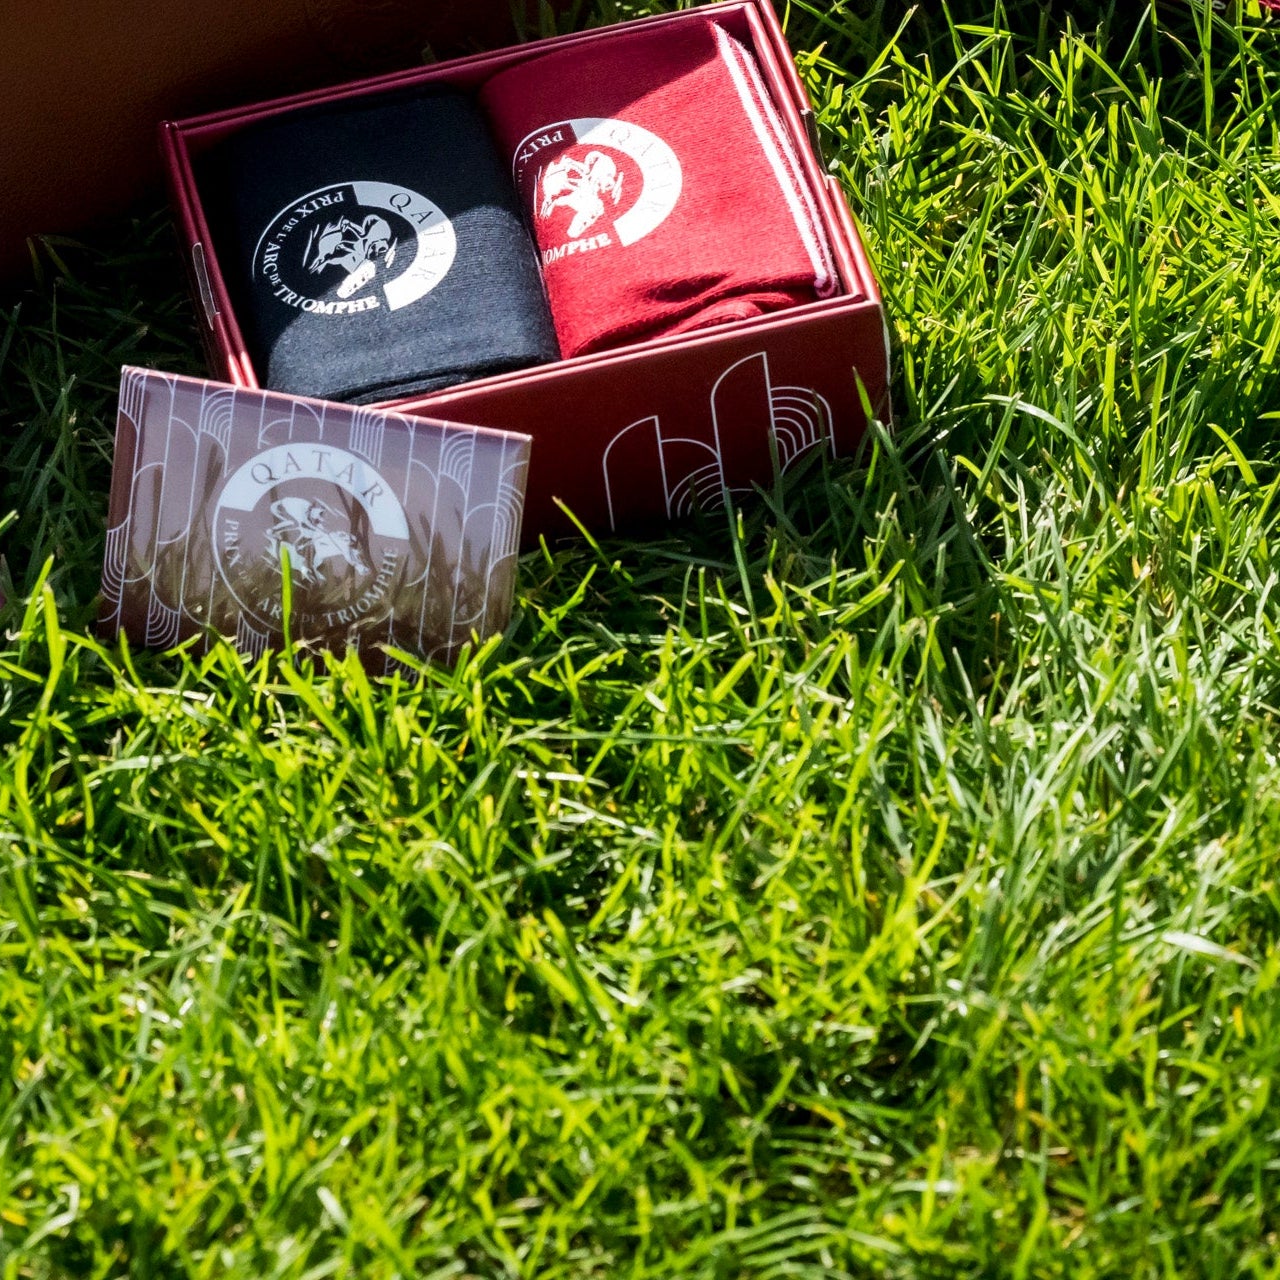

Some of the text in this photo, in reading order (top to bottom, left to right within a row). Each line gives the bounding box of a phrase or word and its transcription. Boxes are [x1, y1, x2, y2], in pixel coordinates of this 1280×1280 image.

[262, 190, 381, 316] PRIX DE L'ARC DE TRIOMPHE
[519, 129, 613, 265] PRIX IOMPHE
[250, 449, 384, 508] QATAR
[224, 518, 243, 569] PRIX
[325, 546, 399, 628] TRIOMPHE
